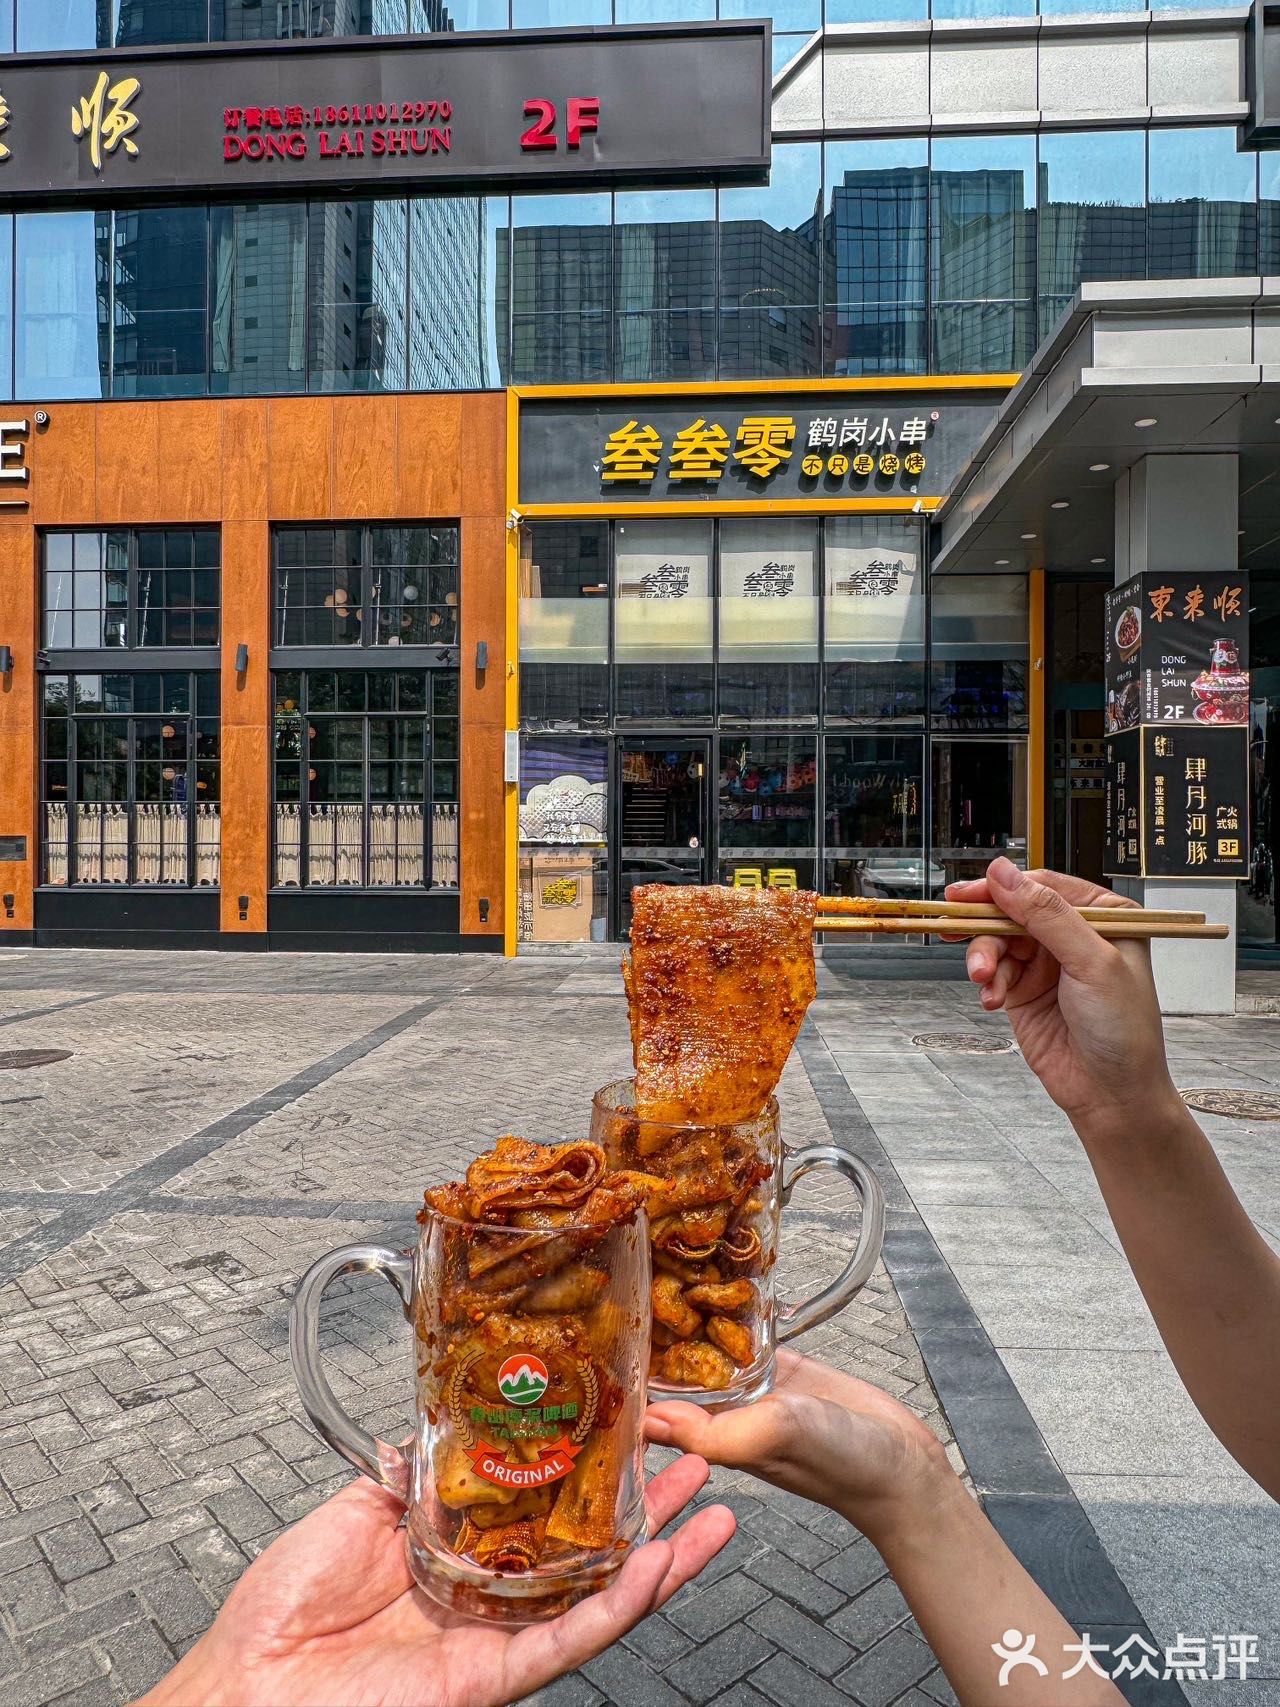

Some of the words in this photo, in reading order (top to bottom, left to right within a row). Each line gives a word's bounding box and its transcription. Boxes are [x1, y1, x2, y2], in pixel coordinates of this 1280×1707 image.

[520, 97, 600, 151] 2F
[223, 133, 305, 161] DONG
[318, 130, 365, 157] LAI
[371, 128, 452, 155] SHUN
[808, 416, 927, 447] 鹤岗小串
[601, 416, 796, 481] 叁叁零
[802, 452, 926, 476] 不只是烧烤
[1161, 655, 1187, 664] DONG
[1161, 667, 1175, 676] LAI
[1161, 679, 1187, 688] SHUN
[1163, 705, 1185, 719] 2F
[1154, 775, 1165, 846] 营业至凌晨一点
[1220, 841, 1237, 853] 3F
[482, 1459, 565, 1484] ORIGINAL
